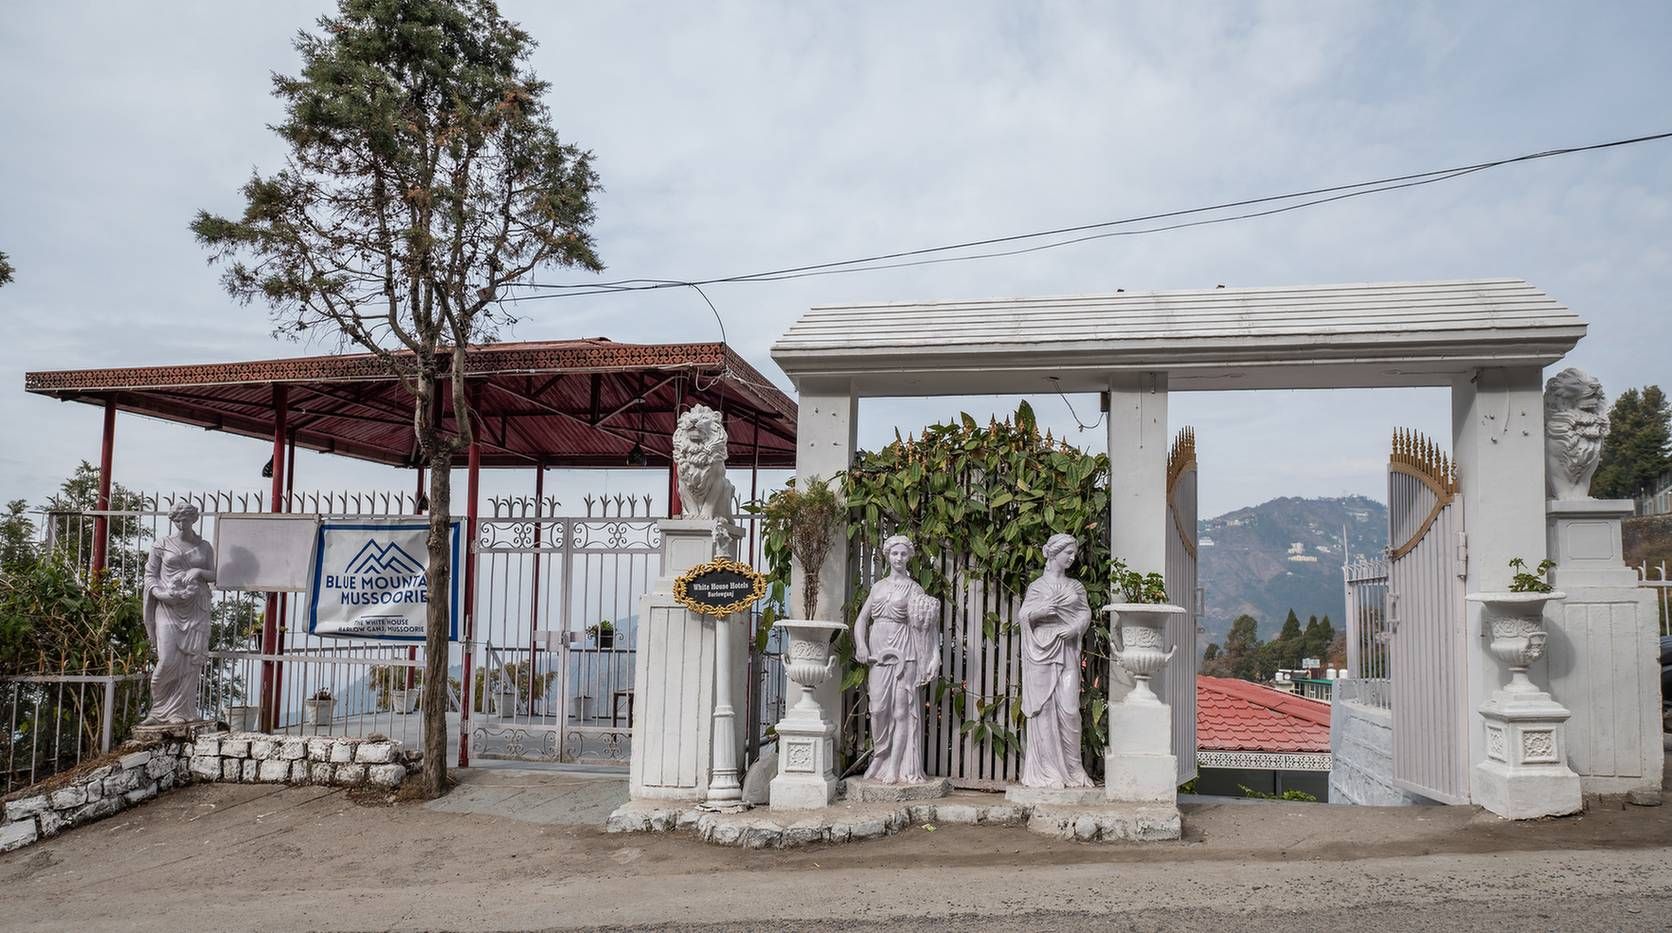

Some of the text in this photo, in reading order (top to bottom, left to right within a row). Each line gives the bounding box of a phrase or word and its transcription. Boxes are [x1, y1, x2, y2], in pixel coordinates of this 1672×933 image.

[326, 575, 429, 589] BLUE MOUNTA
[341, 590, 429, 604] MUSSOORIE
